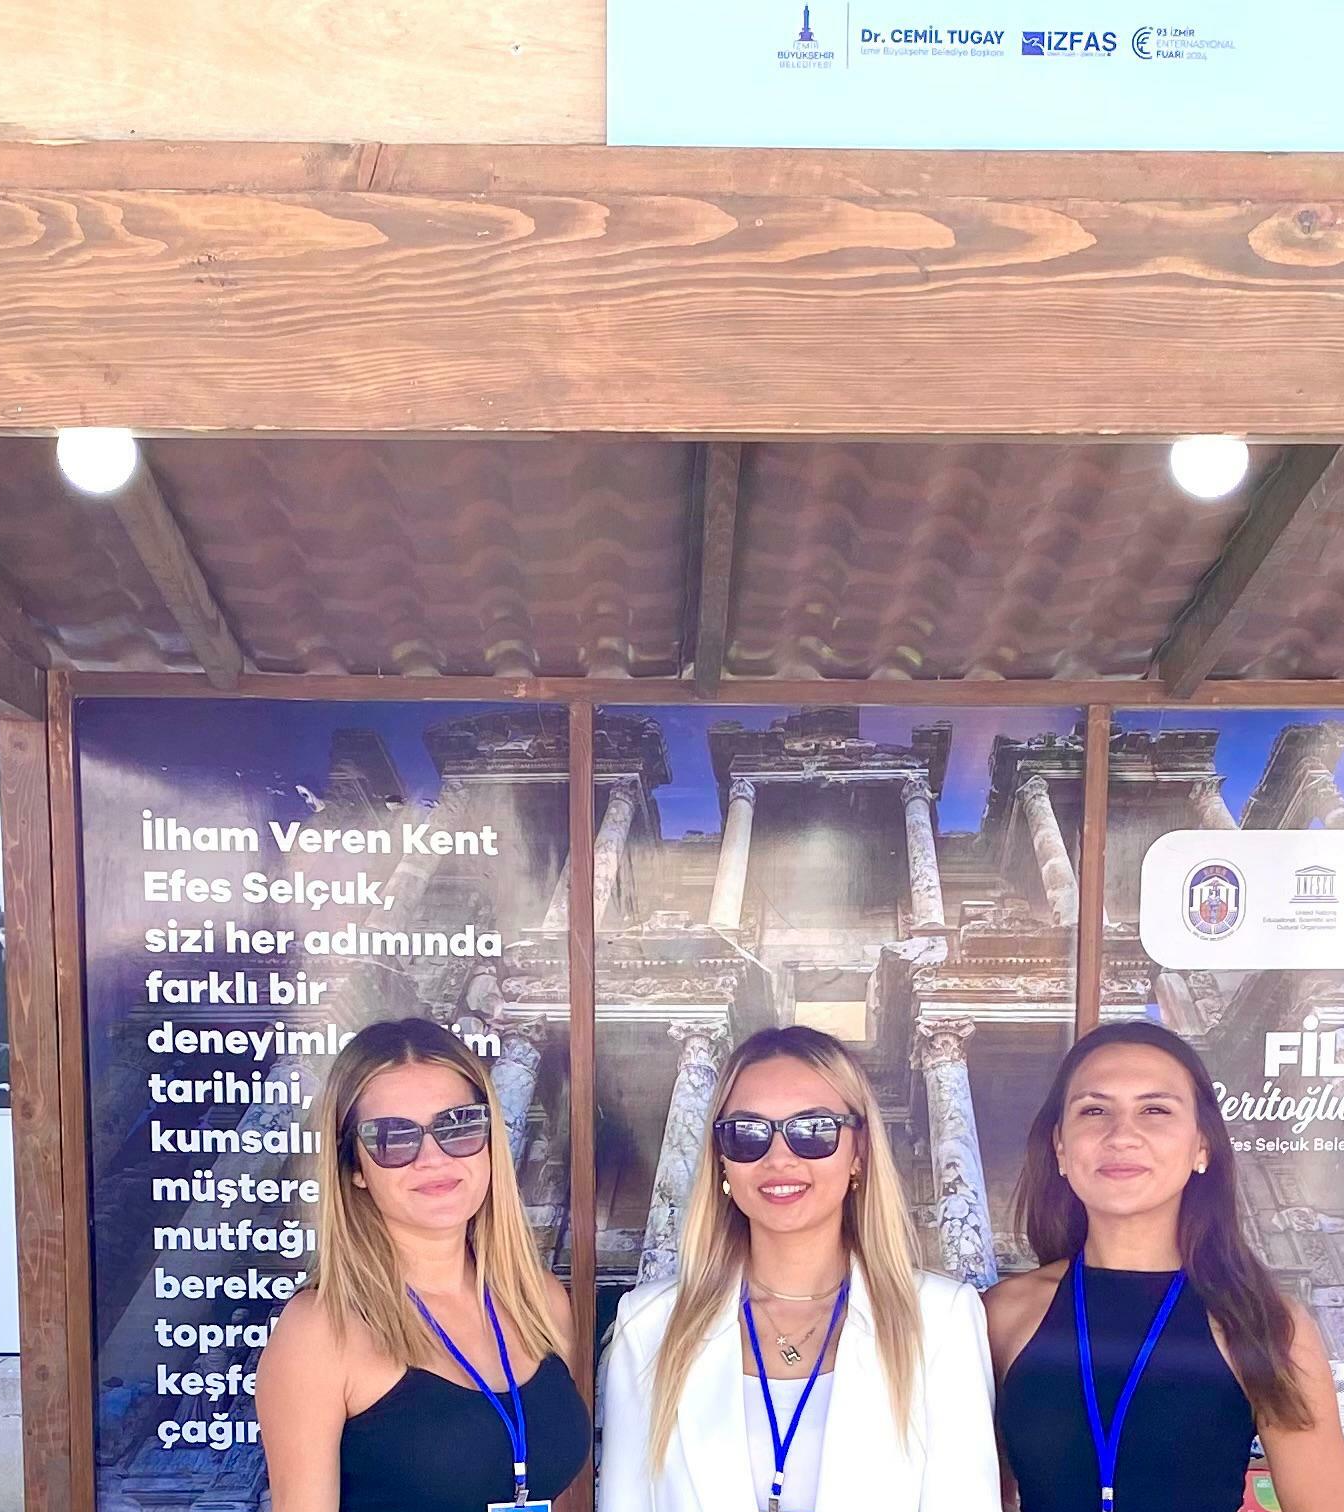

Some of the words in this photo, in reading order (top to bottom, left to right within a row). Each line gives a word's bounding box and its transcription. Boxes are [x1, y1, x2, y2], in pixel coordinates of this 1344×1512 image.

[861, 28, 886, 43] Dr.
[891, 25, 943, 44] CEMİL
[947, 30, 1004, 45] TUGAY
[142, 809, 258, 852] İlham
[269, 821, 391, 854] Veren
[402, 823, 499, 856] Kent
[144, 869, 231, 903] Efes
[243, 872, 395, 911] Selçuk,
[145, 919, 214, 953] sizi
[226, 922, 294, 955] her
[304, 924, 502, 957] adımında
[146, 970, 257, 1004] farklı
[270, 972, 327, 1006] bir
[149, 1071, 313, 1110] tarihini,
[1229, 1137, 1252, 1152] fes
[1255, 1137, 1309, 1154] Selçuk
[152, 1169, 320, 1209] müştere
[153, 1219, 316, 1259] mutfağı
[155, 1317, 274, 1354] topra
[157, 1364, 258, 1403] keşfe
[157, 1412, 261, 1450] çağır
